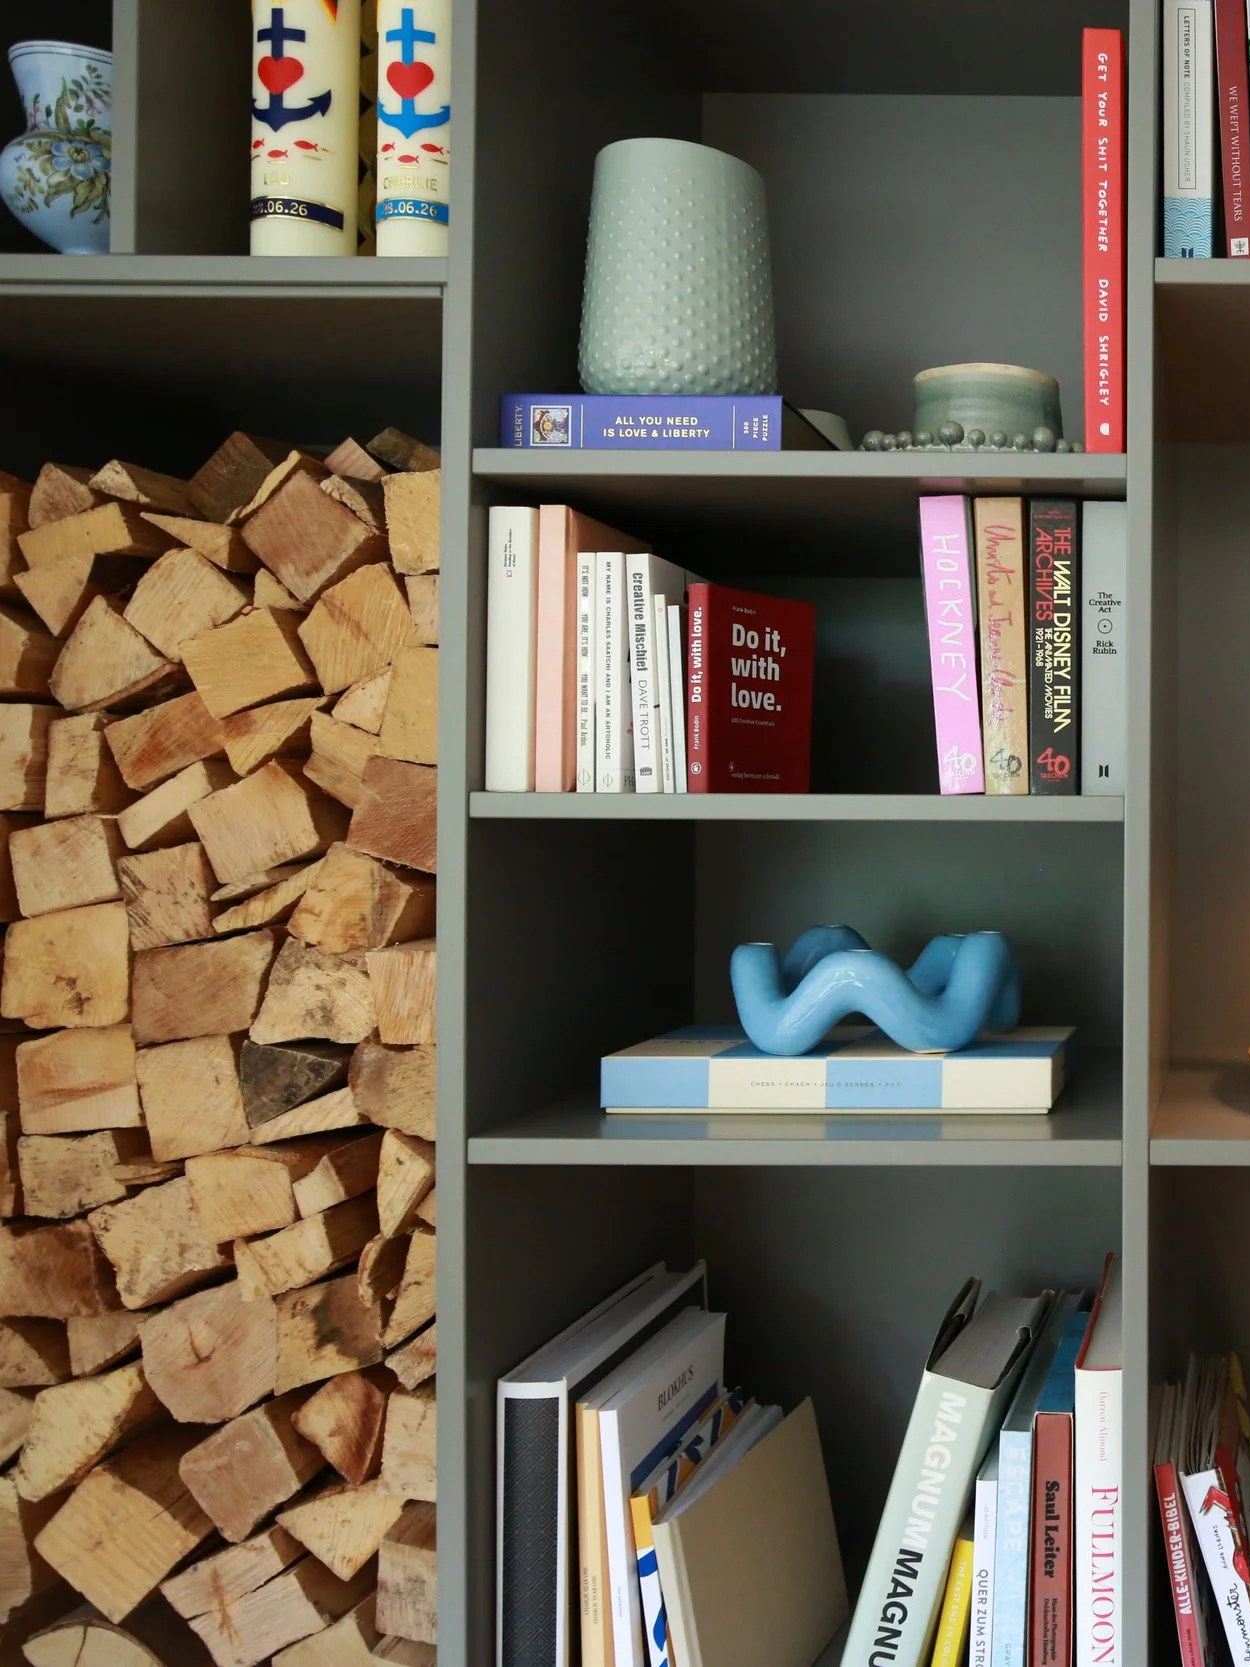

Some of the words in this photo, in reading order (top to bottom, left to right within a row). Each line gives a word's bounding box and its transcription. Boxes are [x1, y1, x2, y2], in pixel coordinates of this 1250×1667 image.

[1183, 15, 1191, 46] LETTERS
[1098, 53, 1108, 82] GET
[1184, 48, 1191, 58] OF
[1229, 85, 1237, 102] WE
[1229, 105, 1239, 133] WEPT
[1098, 138, 1108, 172] SHIT
[1231, 136, 1241, 186] WITHOUT
[1098, 180, 1108, 252] TOGETHER
[1233, 190, 1243, 222] TEARS
[1098, 279, 1109, 322] DAVID
[1098, 336, 1109, 406] SHRIGLEY
[603, 428, 615, 437] IS
[619, 428, 647, 437] LOVE
[651, 428, 658, 437] &
[662, 428, 710, 438] LIBERTY
[615, 416, 634, 425] ALL
[639, 416, 662, 425] YOU
[667, 416, 698, 425] NEED
[1054, 528, 1071, 554] THE
[605, 562, 612, 573] MY
[1036, 527, 1053, 621] ARCHIVES
[1054, 560, 1071, 607] WALT
[1097, 591, 1112, 599] The
[690, 607, 701, 637] love.
[932, 534, 971, 702] HOCKNEY
[634, 624, 648, 672] Mischief
[690, 640, 701, 669] with
[732, 623, 759, 649] Do
[765, 627, 786, 657] it,
[1054, 612, 1071, 680] DISNEY
[1092, 647, 1118, 655] Rubin
[690, 671, 703, 684] it,
[731, 654, 780, 681] with
[1044, 641, 1053, 683] ANIMATED
[605, 695, 612, 706] AM
[638, 680, 649, 709] DAVE
[691, 686, 701, 703] Do
[731, 682, 782, 711] love.
[1044, 684, 1053, 718] MOVIES
[1053, 685, 1071, 734] FILM
[605, 708, 612, 718] AN
[639, 714, 650, 750] TROTT
[657, 1364, 694, 1412] BLOKHUS
[1099, 1391, 1108, 1423] Darren
[1099, 1425, 1109, 1462] Almond
[902, 1391, 967, 1549] MAGNUM
[1003, 1446, 1027, 1552] ESCAPE
[1045, 1480, 1061, 1520] Saul
[1045, 1525, 1060, 1578] Leiter
[1164, 1491, 1192, 1615] ALLE-KINDER-BIBEL
[976, 1569, 989, 1604] QUER
[1091, 1485, 1119, 1665] FULLMOON
[953, 1581, 964, 1603] EAST
[948, 1605, 958, 1624] END
[976, 1609, 987, 1636] ZUM
[1004, 1643, 1012, 1666] GRAY
